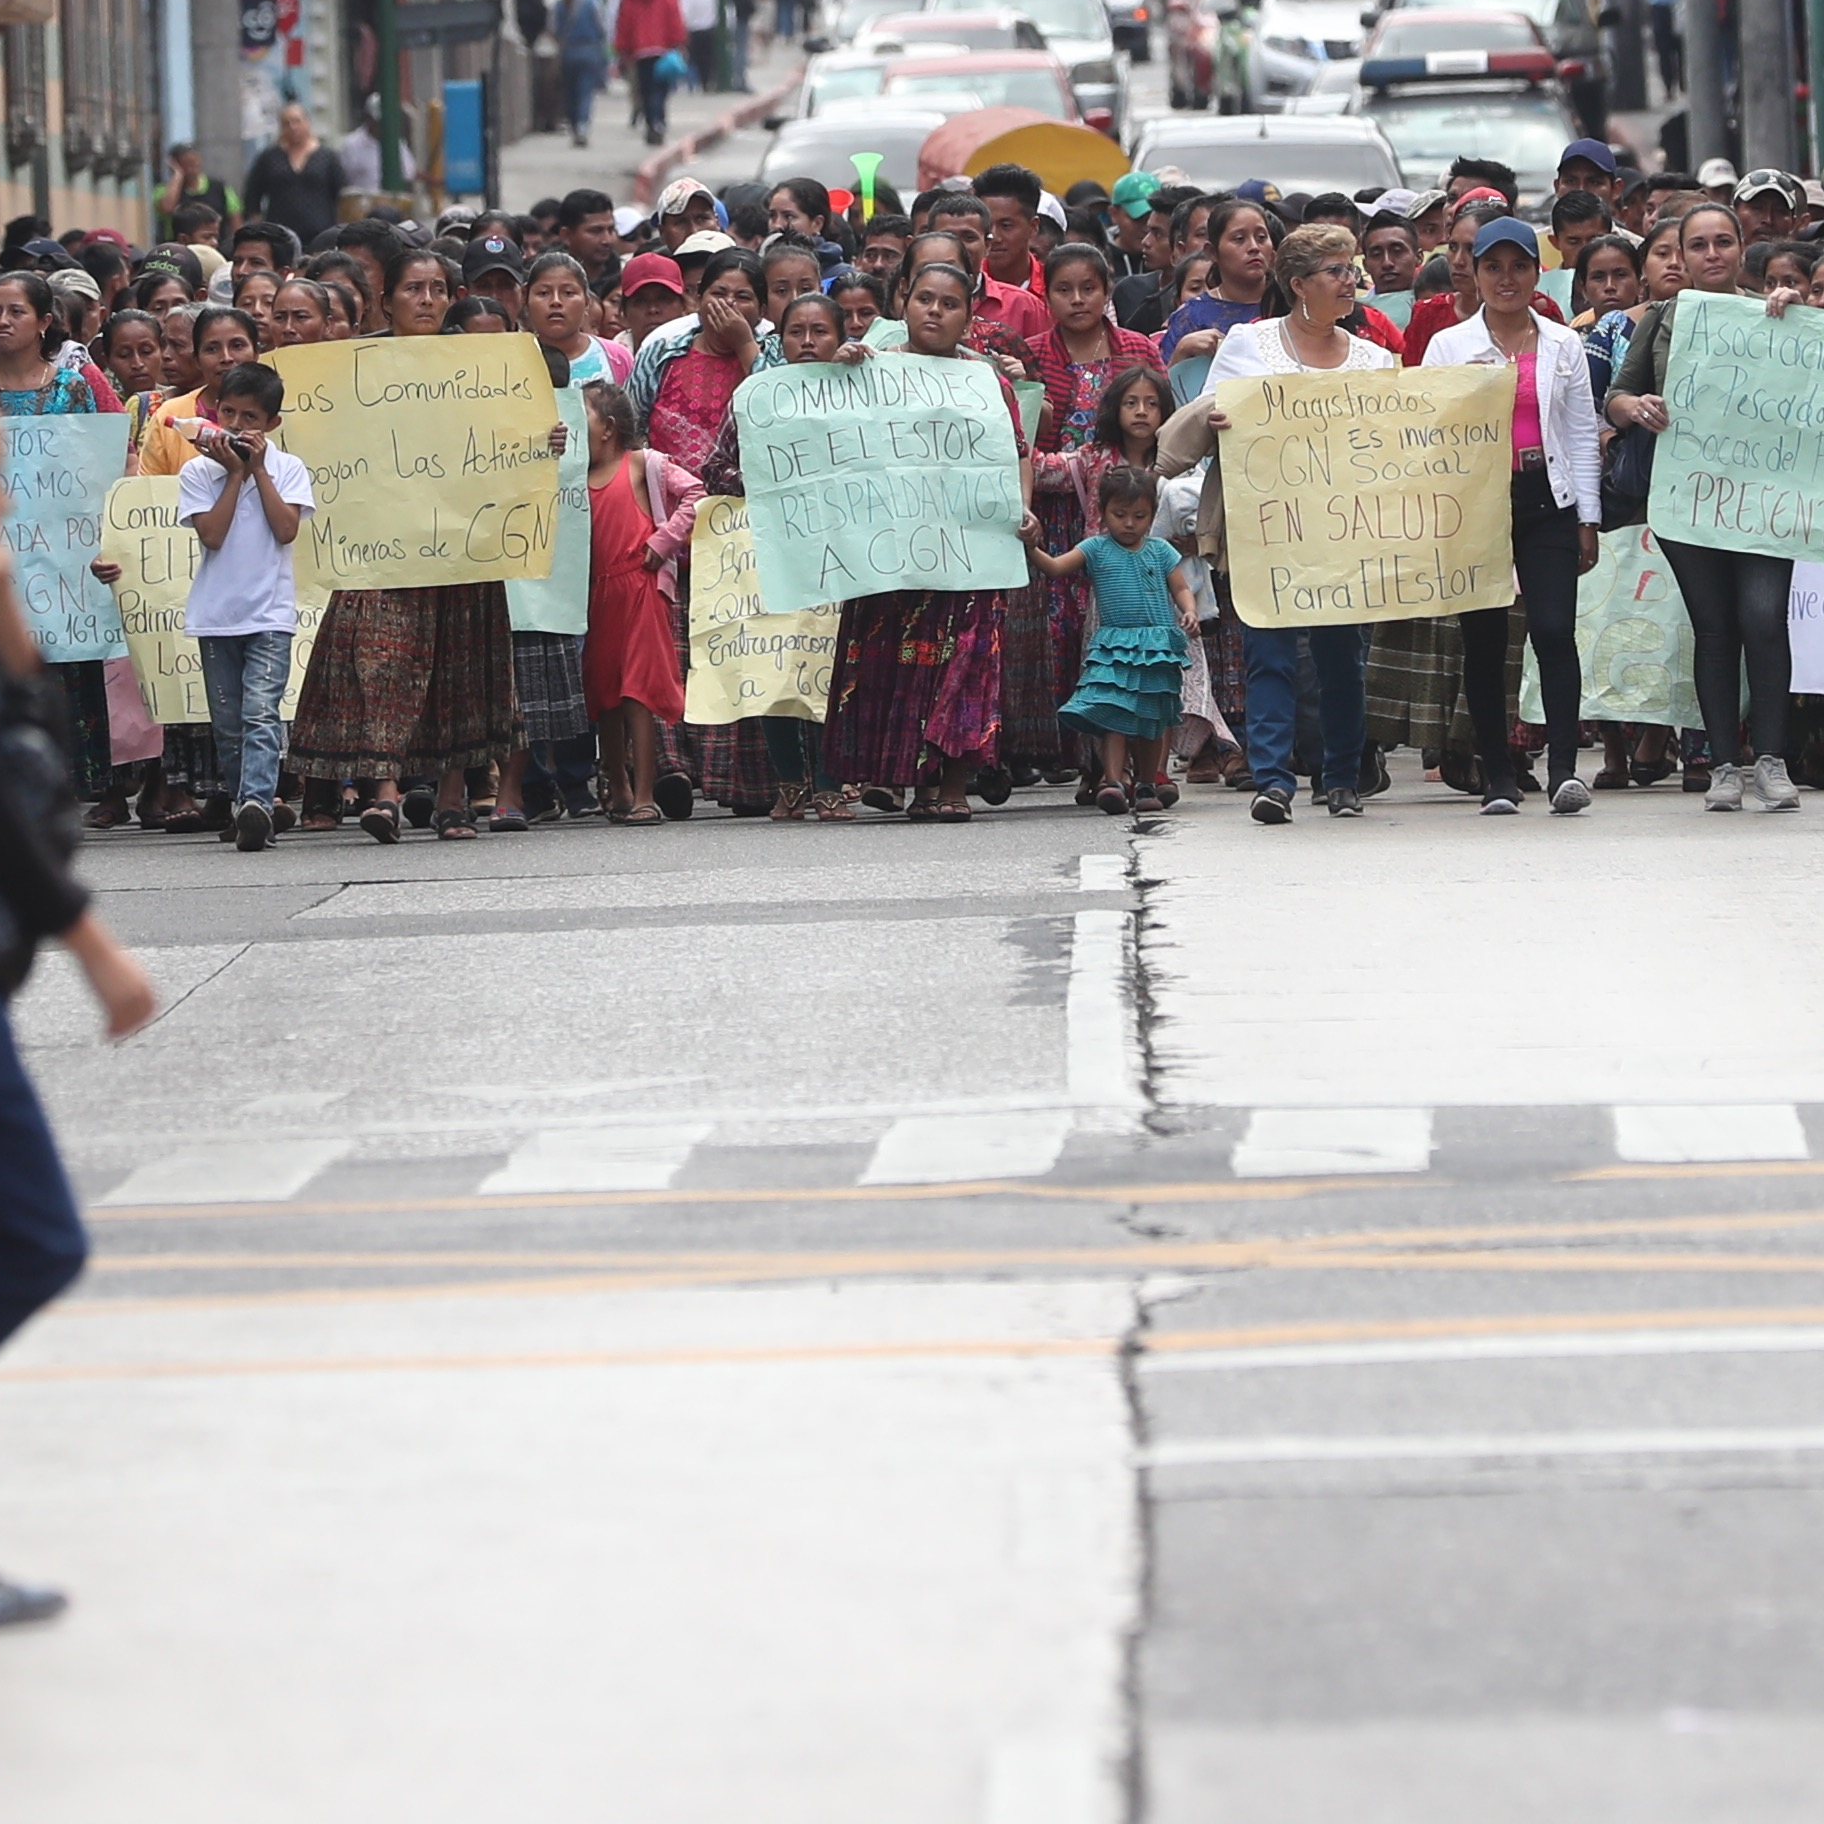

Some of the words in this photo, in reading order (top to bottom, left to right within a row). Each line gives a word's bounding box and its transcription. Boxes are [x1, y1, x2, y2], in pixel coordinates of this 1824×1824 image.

[144, 259, 181, 275] adidas
[353, 344, 533, 407] Comunidades
[747, 366, 988, 429] COMUNIDADES
[1256, 380, 1436, 433] Magistrados
[391, 428, 445, 479] Las
[767, 439, 820, 482] DE
[827, 426, 875, 466] EL
[887, 419, 998, 463] ESTOR
[1244, 435, 1331, 493] CGN
[1670, 417, 1760, 473] Bocas
[1766, 430, 1801, 473] del
[780, 469, 1014, 540] RESPALDAMOS
[1259, 497, 1303, 546] EN
[1327, 493, 1463, 541] SALUD
[139, 535, 172, 585] El
[311, 516, 406, 576] Mineras
[419, 507, 450, 558] de
[466, 496, 558, 567] CGN
[820, 543, 856, 589] A
[868, 525, 972, 574] CGN
[10, 564, 87, 615] GN
[1270, 566, 1355, 615] Para
[1359, 557, 1386, 608] El
[1394, 548, 1484, 604] Estor
[65, 613, 98, 646] 169
[157, 640, 202, 677] Los
[732, 679, 766, 707] a
